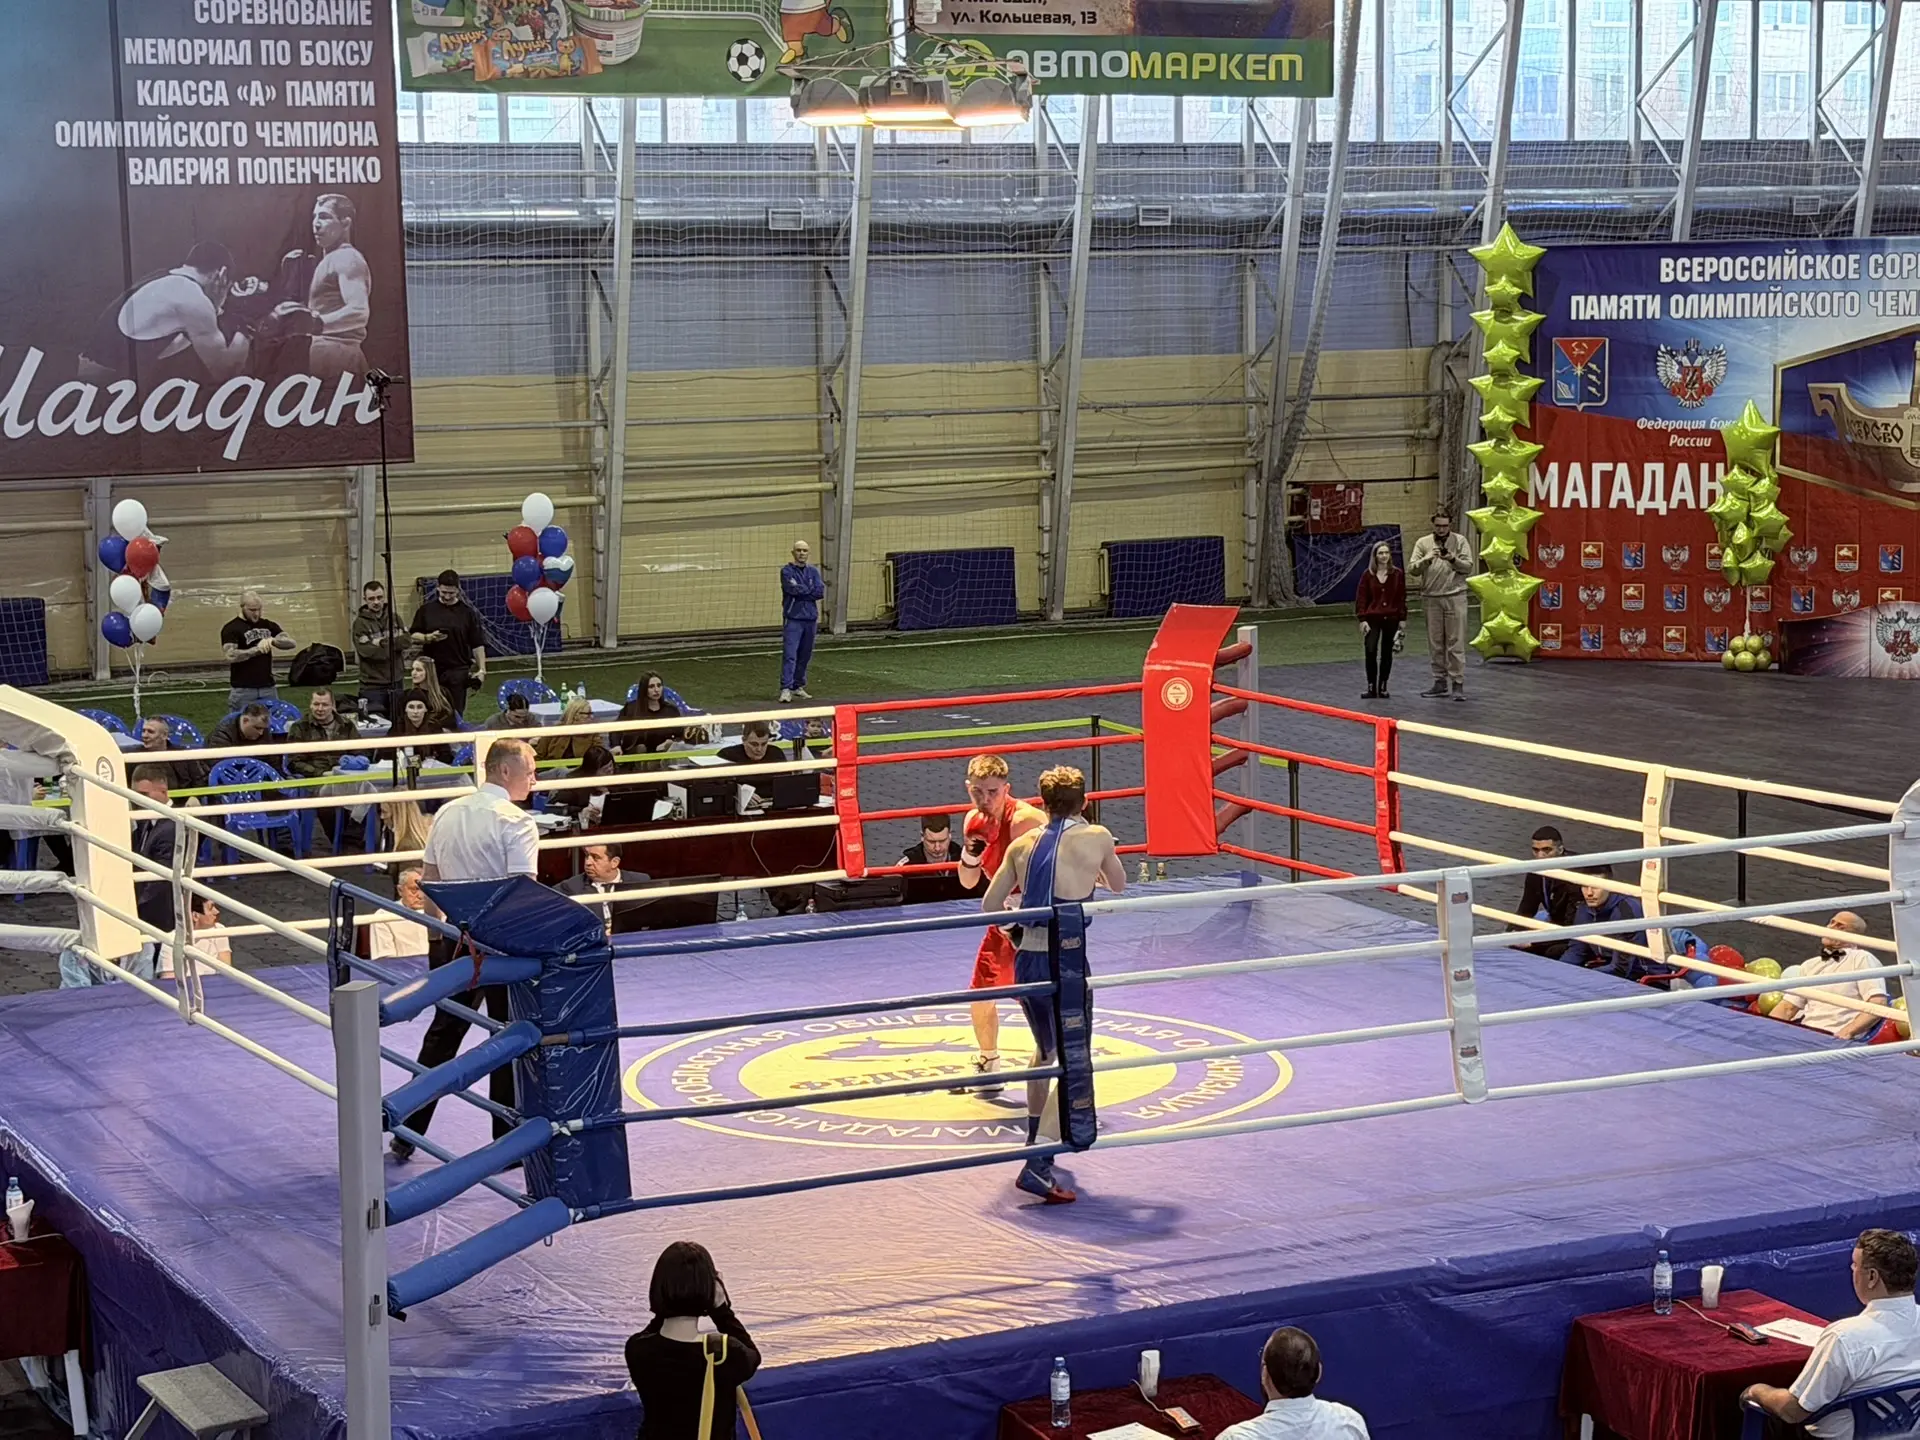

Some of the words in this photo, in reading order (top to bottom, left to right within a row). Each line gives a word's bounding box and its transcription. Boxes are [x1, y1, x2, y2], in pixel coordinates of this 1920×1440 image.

[194, 0, 373, 26] СОРЕВНОВАНИЕ
[950, 11, 975, 25] ул.
[979, 9, 1076, 27] Кольцевая,
[1080, 11, 1097, 25] 13
[124, 38, 252, 66] МЕМОРИАЛ
[260, 39, 291, 66] ПО
[300, 40, 373, 67] БОКСУ
[136, 79, 230, 107] КЛАССА
[236, 80, 277, 106] «А»
[285, 80, 375, 106] ПАМЯТИ
[55, 113, 248, 148] ОЛИМПИЙСКОГО
[255, 121, 379, 147] ЧЕМПИОНА
[128, 157, 230, 186] ВАЛЕРИЯ
[237, 156, 381, 184] ПОПЕНЧЕНКО
[1660, 248, 1861, 283] ВСЕРОССИЙСКОЕ
[1868, 252, 1920, 280] СОР
[1570, 295, 1661, 320] ПАМЯТИ
[1669, 285, 1860, 320] ОЛИМПИЙСКОГО
[1868, 290, 1920, 317] ЧЕМ
[1636, 416, 1706, 432] Федерация
[1668, 434, 1713, 447] России
[1527, 461, 1725, 515] МАГАДАН
